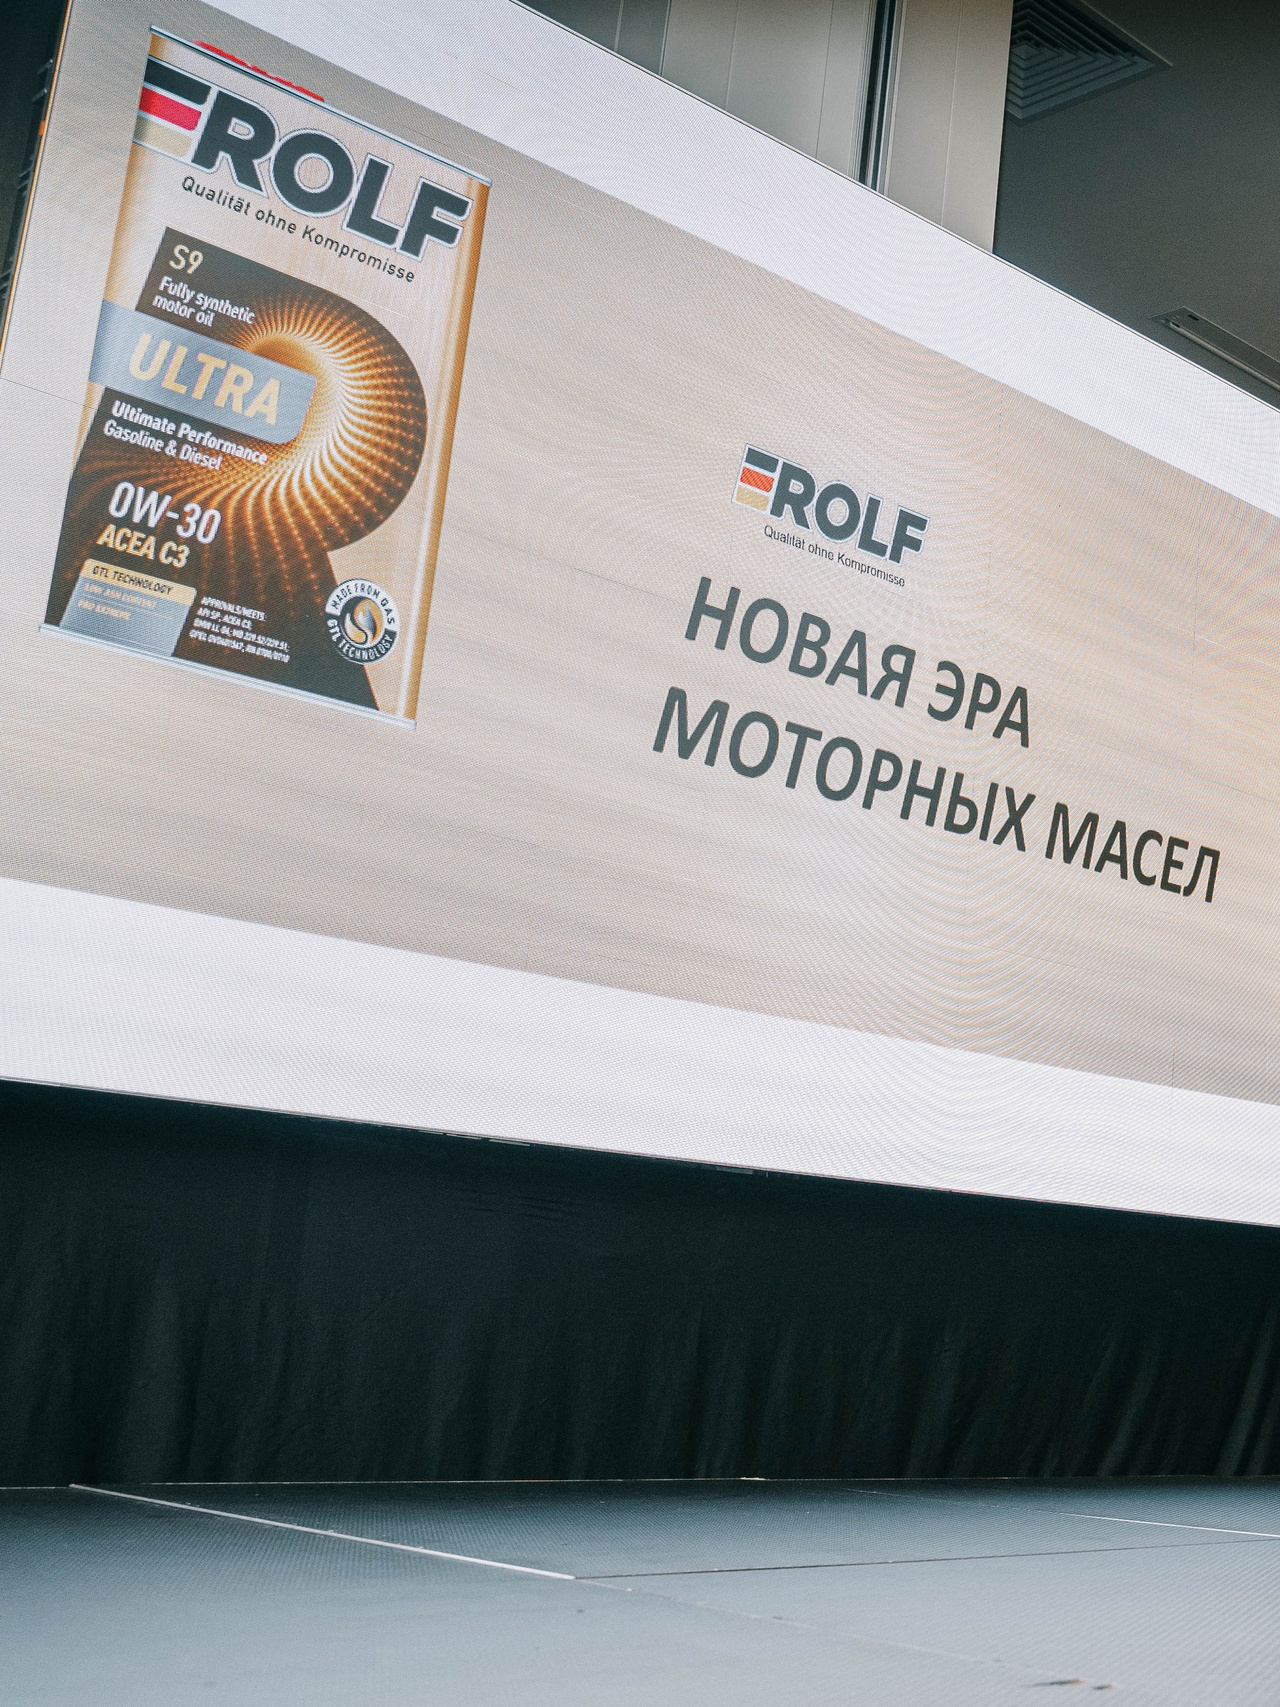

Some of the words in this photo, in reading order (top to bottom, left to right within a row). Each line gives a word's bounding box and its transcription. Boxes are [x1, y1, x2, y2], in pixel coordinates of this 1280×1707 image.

[191, 89, 474, 260] ROLF
[168, 244, 204, 274] S9
[182, 176, 252, 216] Qualität
[254, 210, 297, 234] ohne
[302, 225, 415, 283] Kompromisse
[152, 294, 195, 319] motor
[195, 310, 216, 327] oil
[159, 275, 196, 304] Fully
[195, 292, 256, 324] synthetic
[129, 332, 281, 426] ULTRA
[103, 419, 164, 453] Gasoline
[165, 439, 177, 457] &
[180, 443, 223, 470] Diesel
[111, 400, 177, 435] Ultimate
[178, 422, 268, 465] Performance
[108, 481, 222, 544] 0W-30
[769, 460, 930, 565] ROLF
[96, 523, 157, 560] ACEA
[158, 540, 191, 568] C3
[764, 525, 806, 551] Qualität
[807, 543, 835, 562] ohne
[837, 552, 906, 587] Kompromisse
[92, 565, 109, 579] GTL
[113, 570, 174, 595] TECHNOLOGY
[331, 585, 352, 609] MADE
[354, 583, 380, 599] FROM
[380, 597, 396, 625] GAS
[326, 618, 341, 642] GTL
[338, 634, 393, 661] TECHNOLOGY
[685, 575, 916, 708] НОВАЯ
[926, 660, 1030, 749] ЭРА
[652, 686, 1037, 853] МОТОРНЫХ
[1044, 801, 1221, 903] МАСЕЛ
